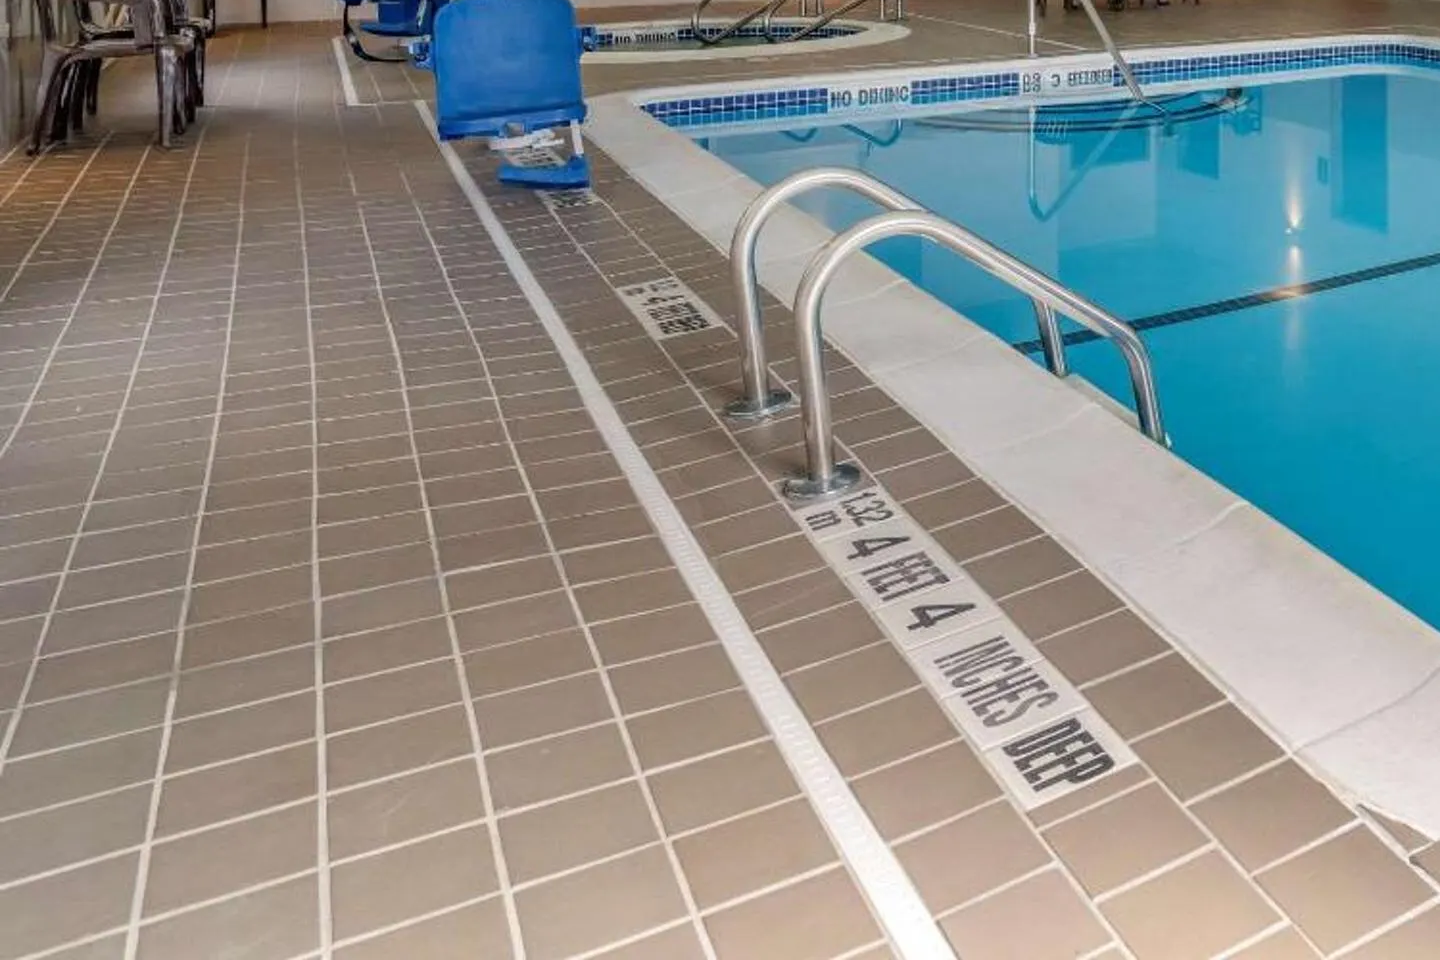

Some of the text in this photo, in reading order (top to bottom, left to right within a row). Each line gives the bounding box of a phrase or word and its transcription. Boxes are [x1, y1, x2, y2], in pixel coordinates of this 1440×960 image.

[805, 509, 841, 531] m
[840, 492, 1116, 793] 1.32 4 FEET 4 INCHES DEEP
